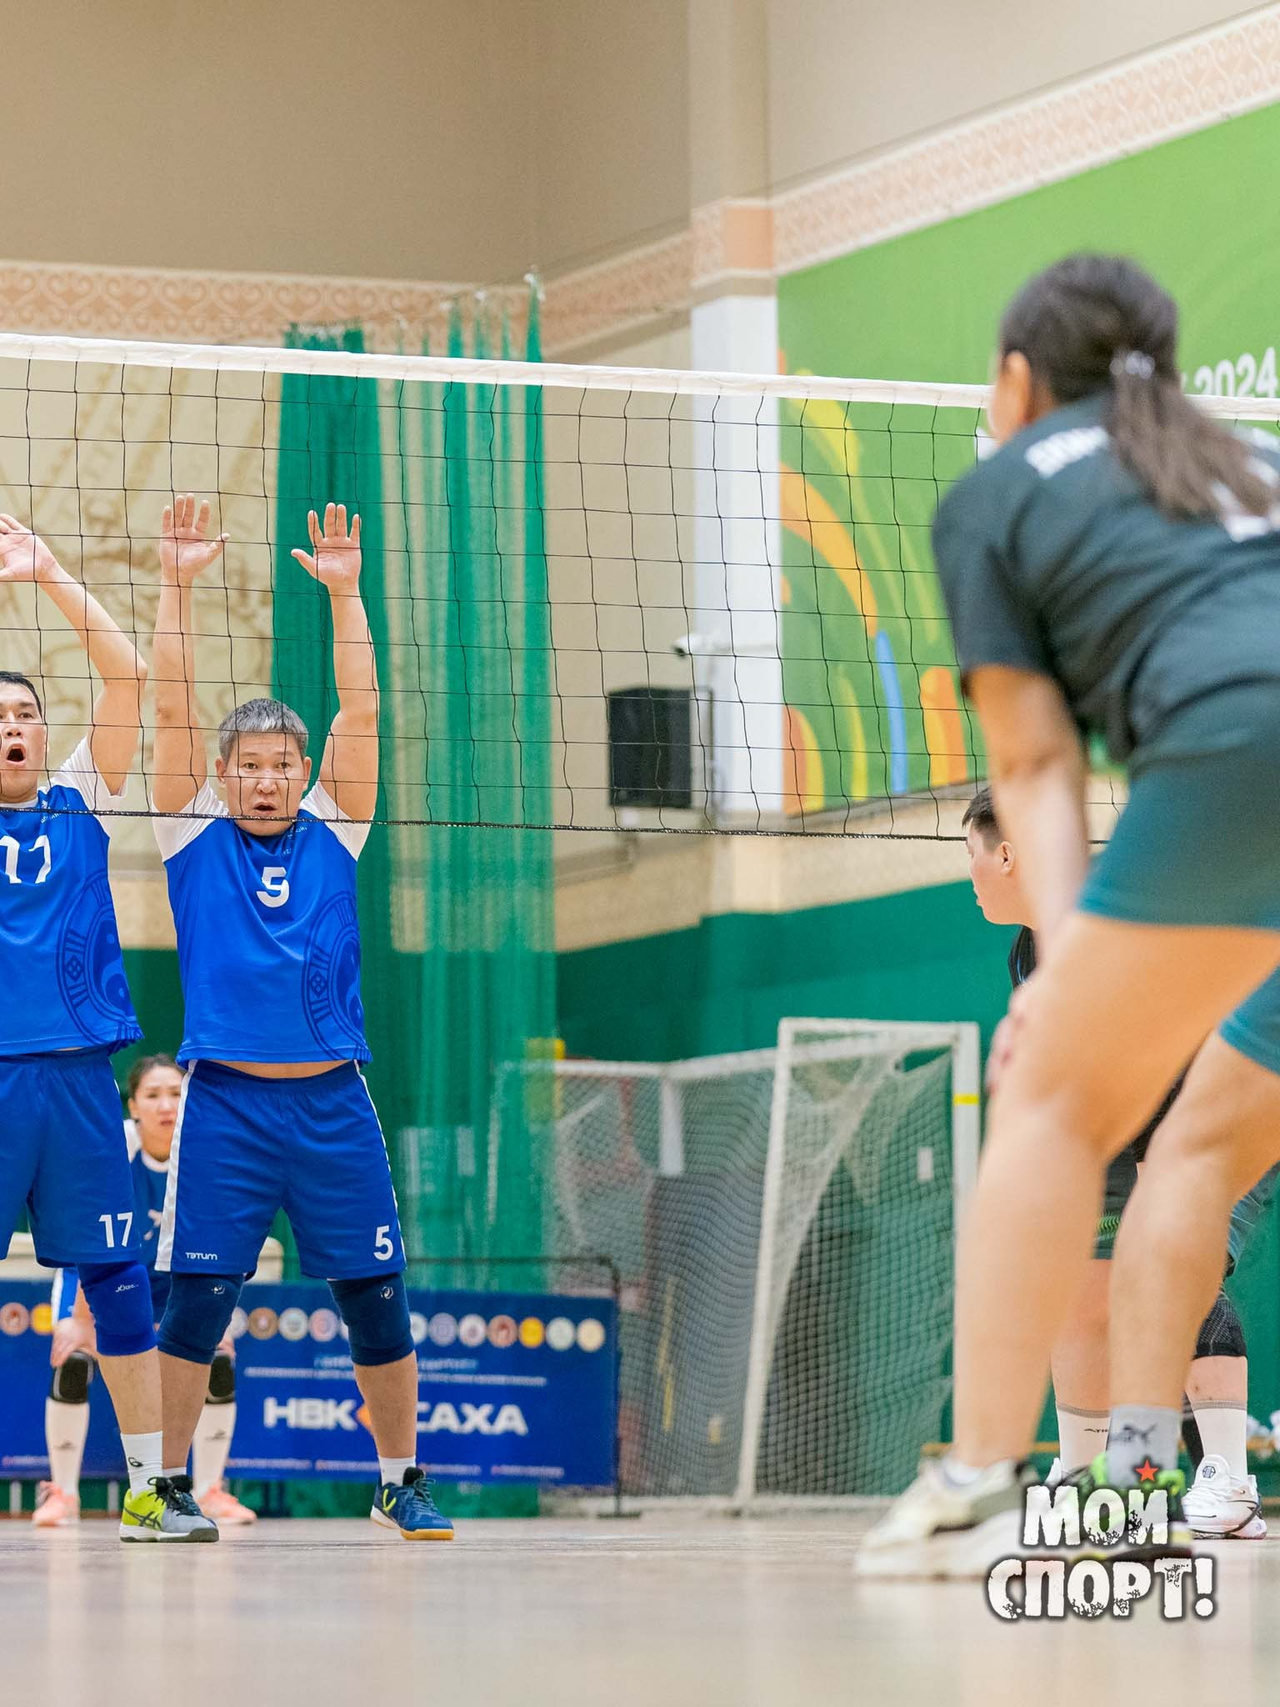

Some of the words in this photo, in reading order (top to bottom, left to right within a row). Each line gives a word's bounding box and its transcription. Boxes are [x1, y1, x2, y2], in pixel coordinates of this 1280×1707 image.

[1194, 346, 1279, 398] 2024
[256, 867, 290, 908] 5
[98, 1211, 134, 1249] 17
[373, 1225, 394, 1261] 5
[263, 1396, 358, 1431] НВК
